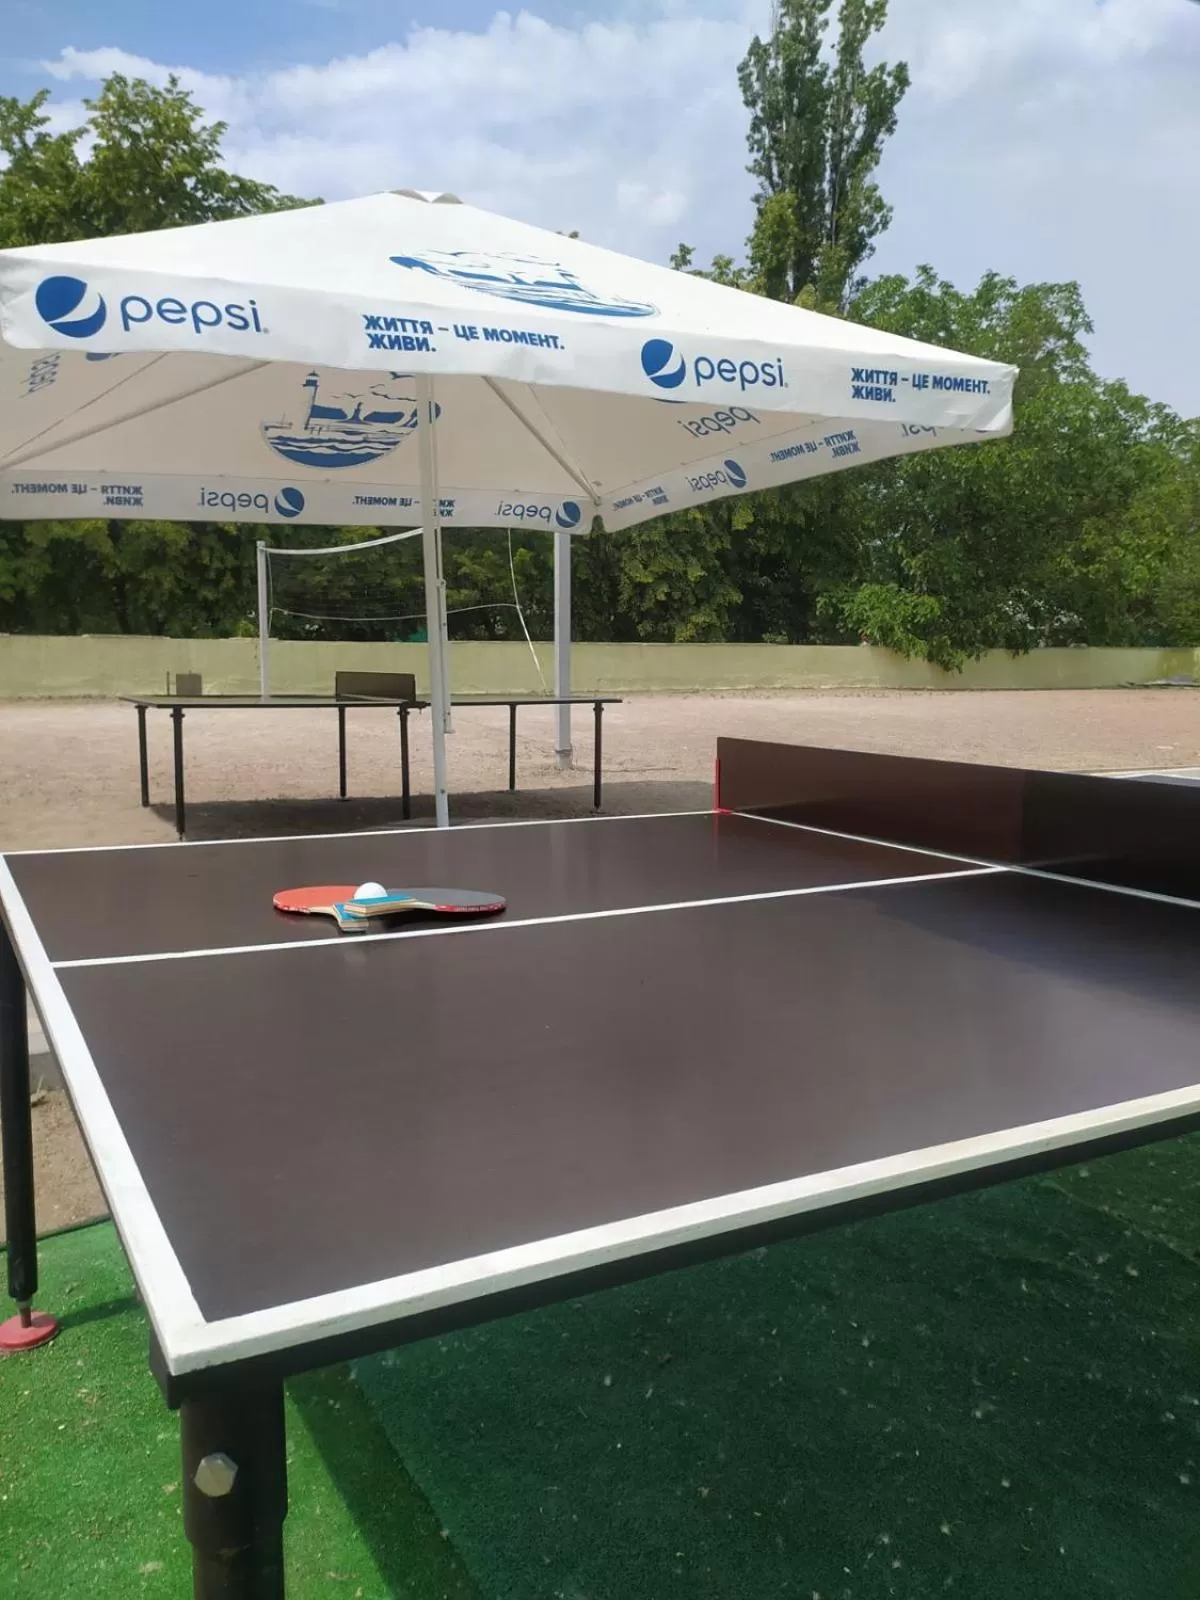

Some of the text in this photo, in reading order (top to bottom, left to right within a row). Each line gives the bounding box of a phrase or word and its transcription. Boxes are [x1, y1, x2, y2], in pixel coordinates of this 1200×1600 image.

[120, 295, 261, 334] pepsi
[362, 314, 434, 335] ЖИТТЯ
[453, 324, 479, 340] ЦЕ
[483, 327, 565, 350] МОМЕНТ.
[367, 333, 436, 352] ЖИВИ.
[694, 356, 784, 391] pepsi
[850, 367, 898, 386] ЖИТТЯ
[912, 373, 929, 390] ЦЕ
[932, 375, 991, 394] МОМЕНТ.
[851, 385, 896, 403] ЖИВИ.
